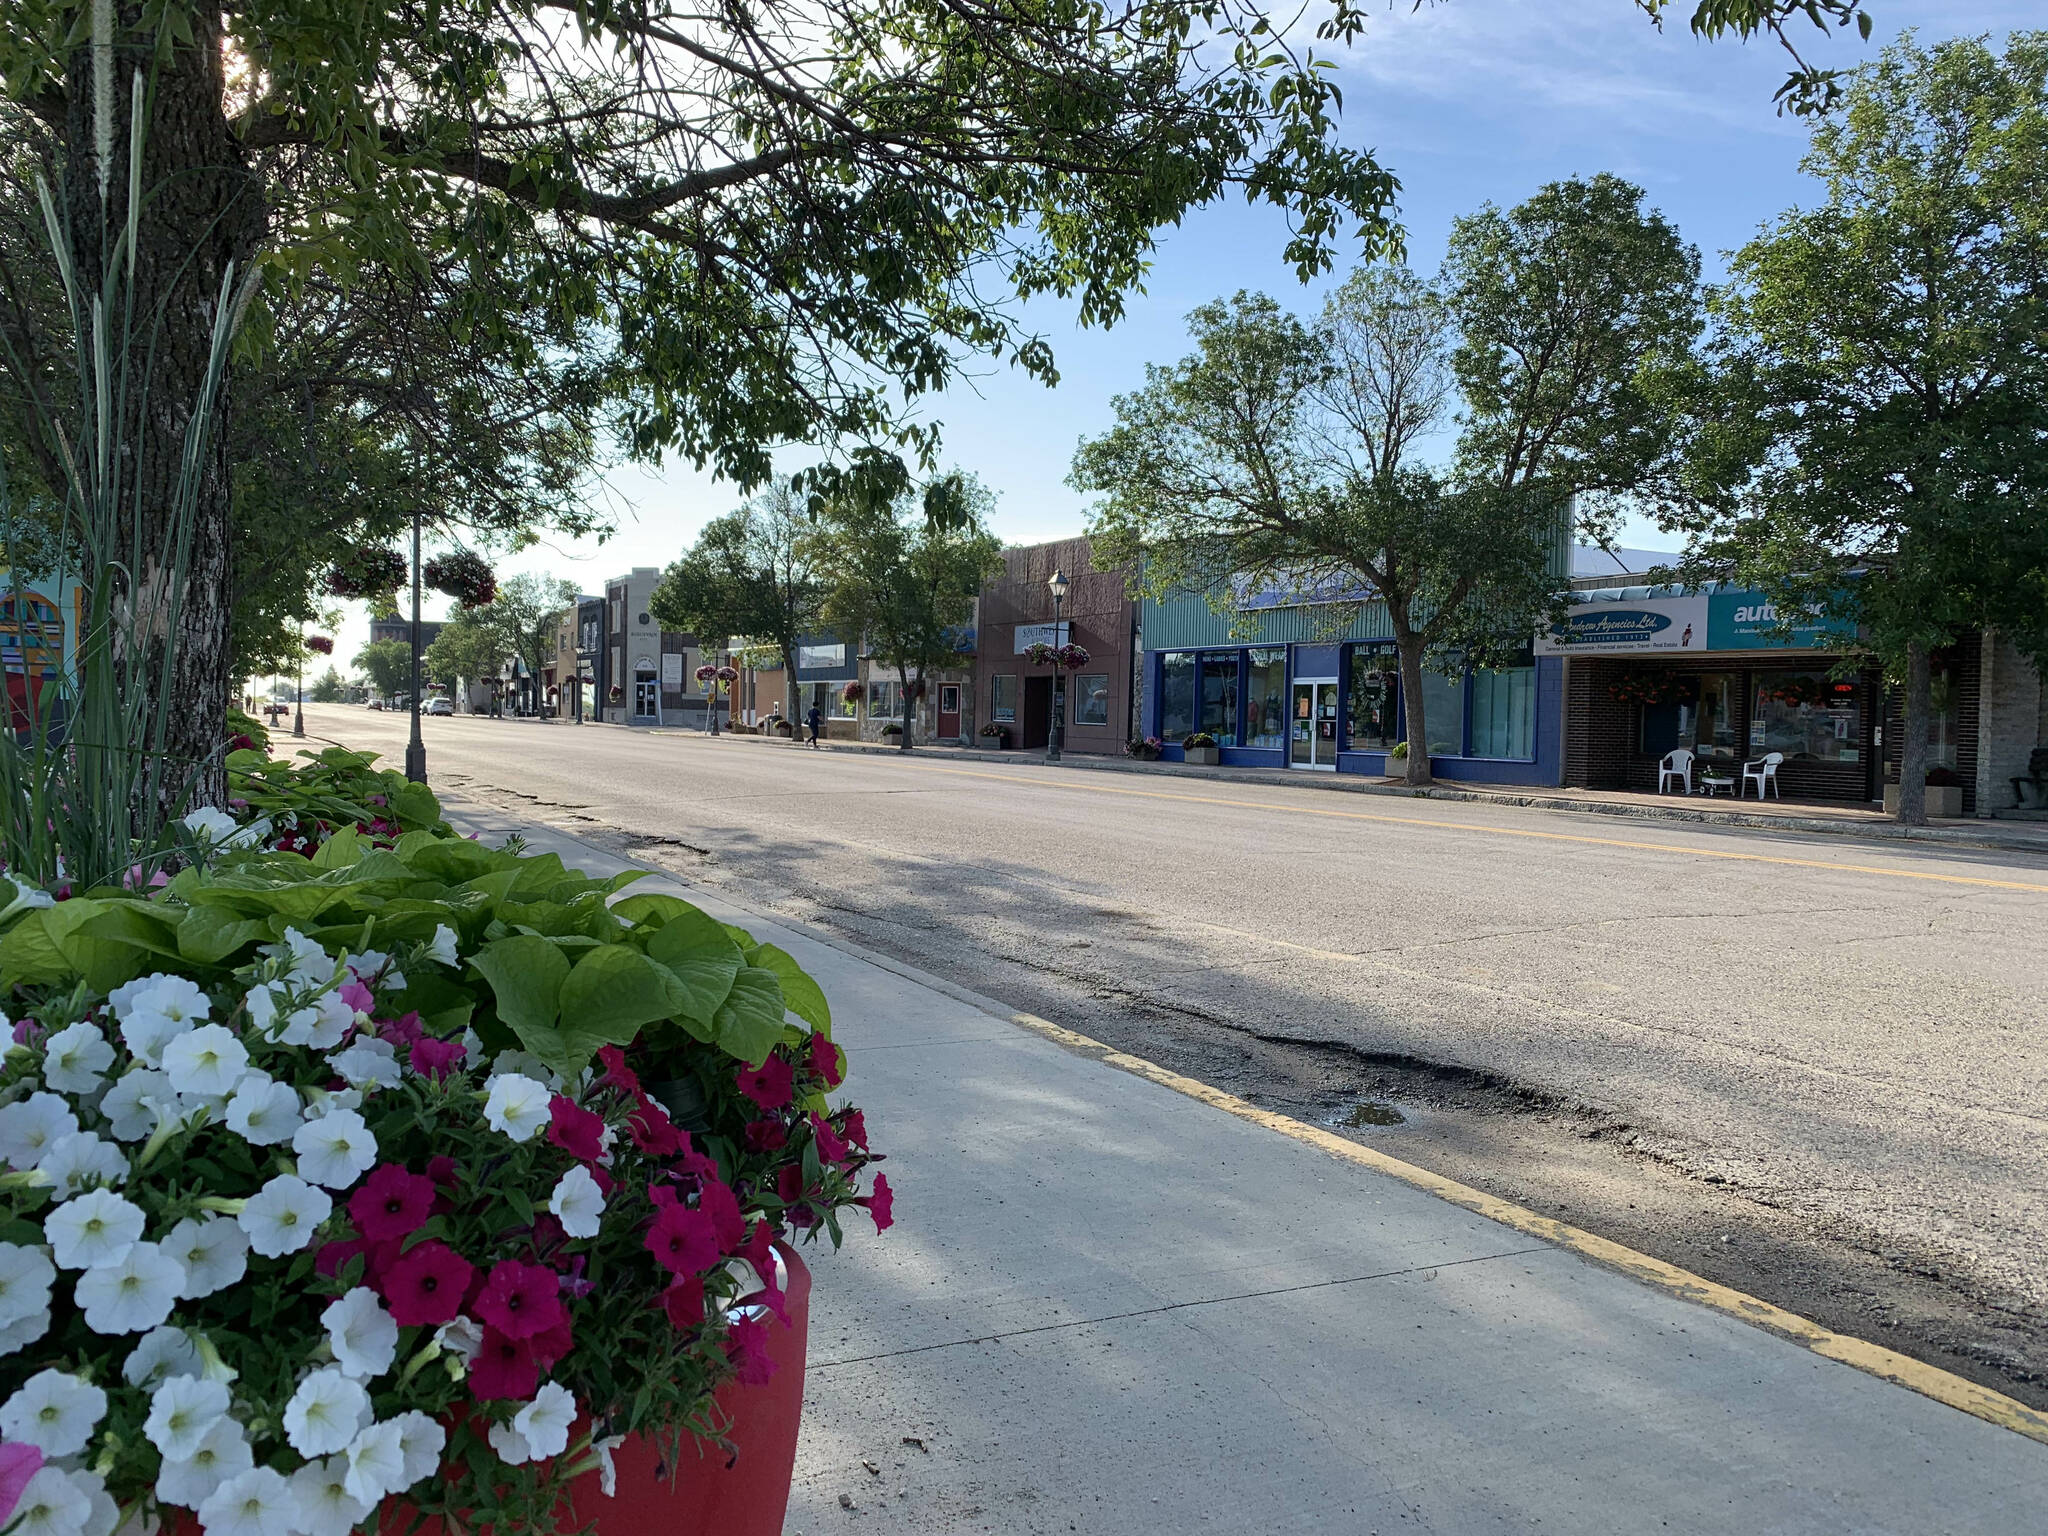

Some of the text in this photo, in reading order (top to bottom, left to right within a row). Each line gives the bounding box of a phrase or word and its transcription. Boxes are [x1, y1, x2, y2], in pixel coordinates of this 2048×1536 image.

[1733, 600, 1828, 624] autoac
[1596, 615, 1636, 632] Agencies
[1636, 613, 1658, 629] Ltd.
[1380, 644, 1396, 655] GOLF
